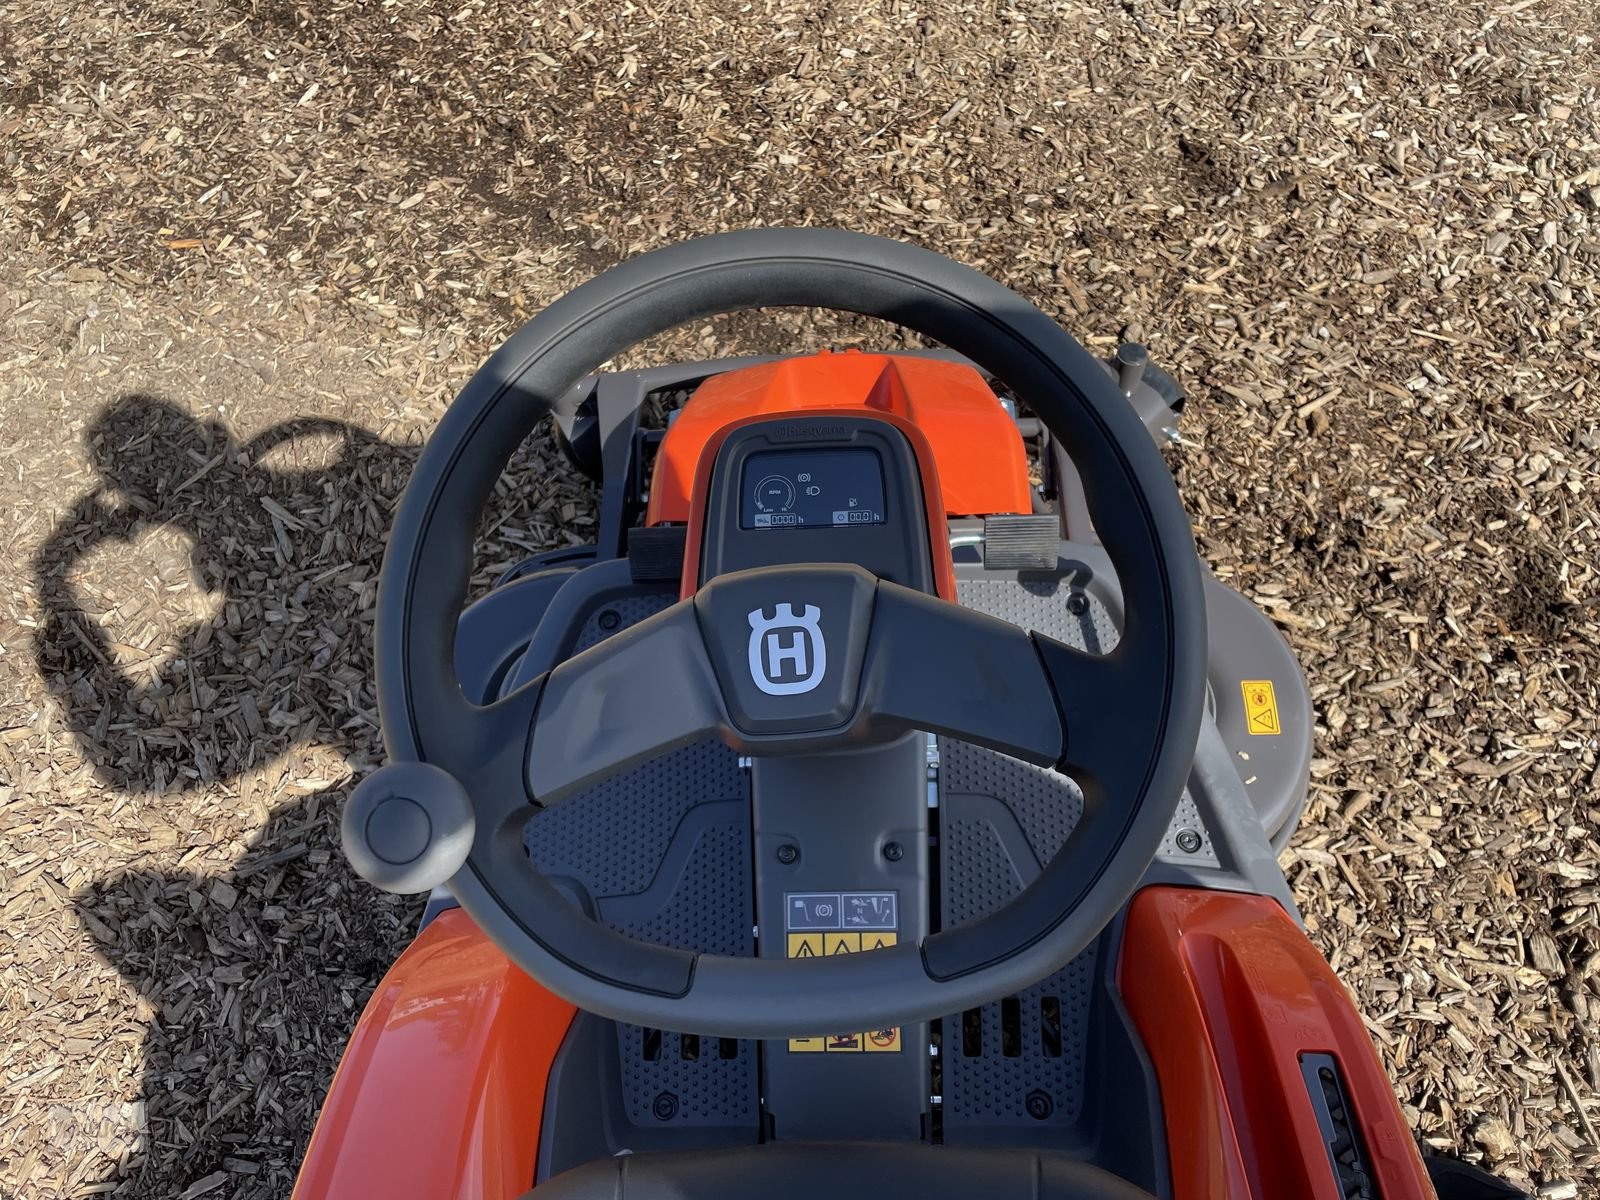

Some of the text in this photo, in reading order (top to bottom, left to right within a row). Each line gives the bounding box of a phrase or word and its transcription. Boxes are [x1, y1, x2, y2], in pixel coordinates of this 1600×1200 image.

[787, 423, 847, 437] Husqvarna
[771, 515, 804, 524] 0000 h
[873, 512, 880, 521] h
[767, 631, 807, 678] H
